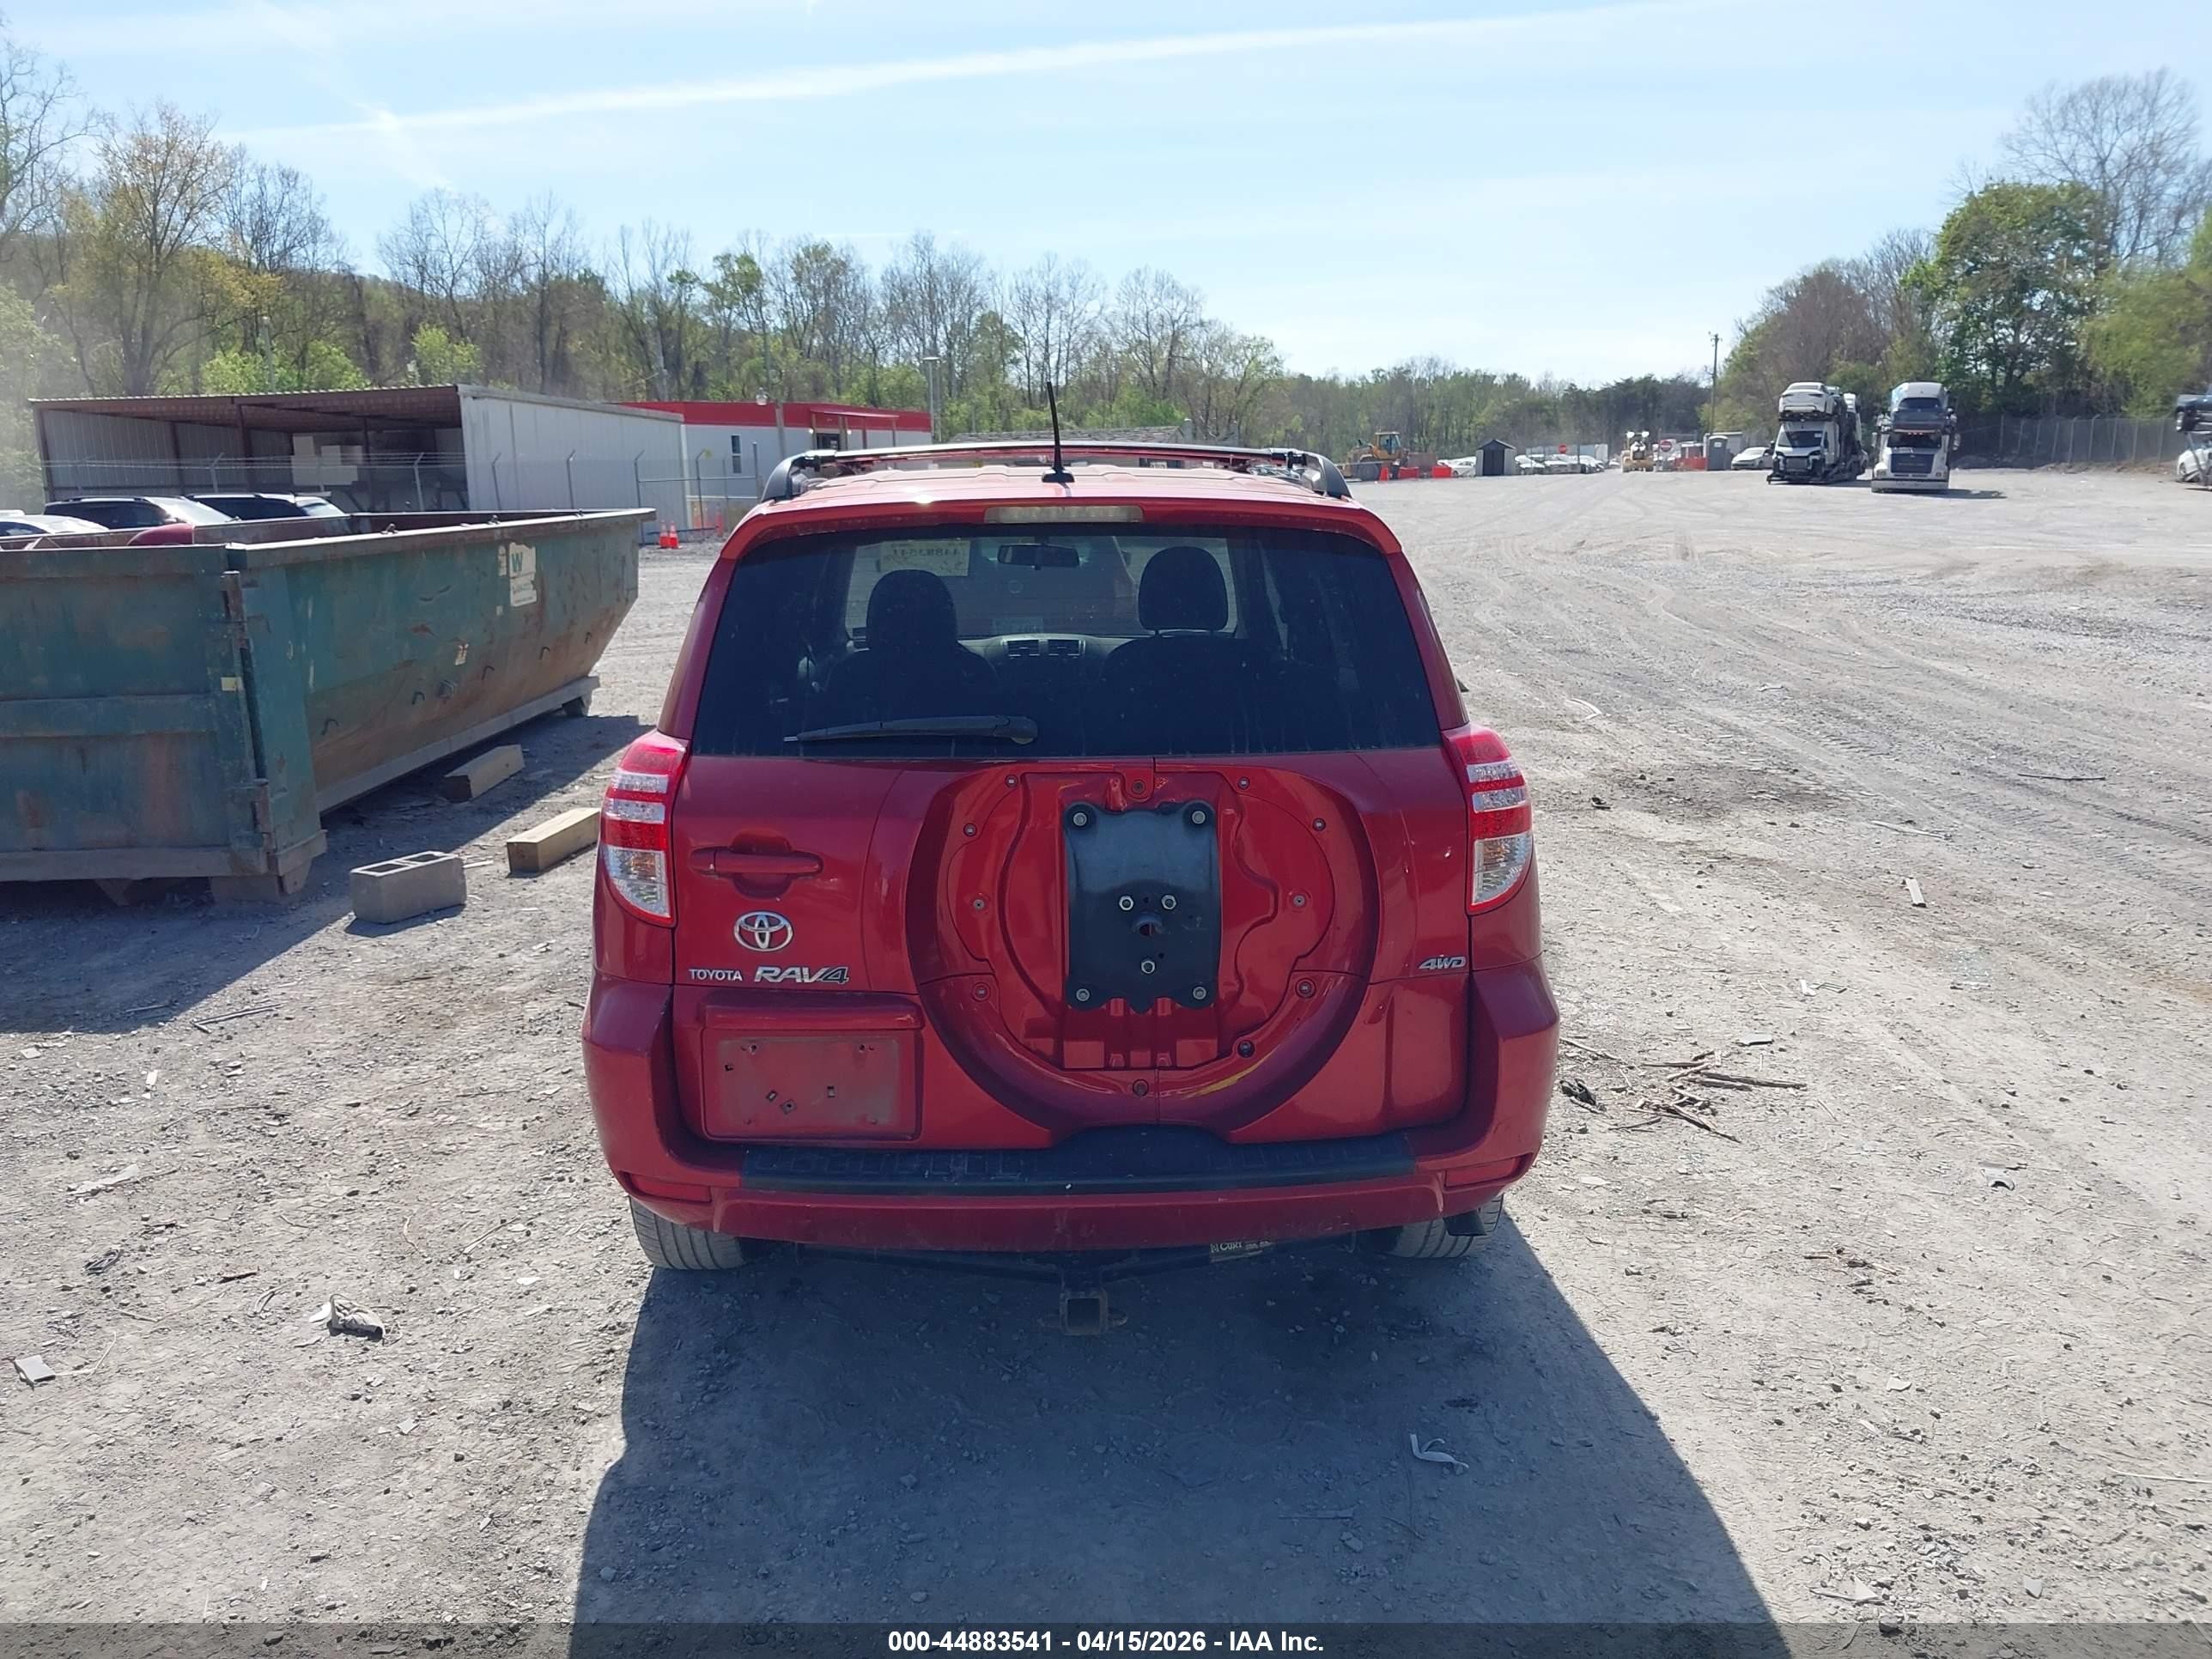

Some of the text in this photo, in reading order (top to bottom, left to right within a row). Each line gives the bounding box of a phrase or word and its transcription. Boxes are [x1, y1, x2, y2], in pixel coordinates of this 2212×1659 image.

[1419, 956, 1467, 970] 4WD
[689, 966, 849, 985] TOYOTA RAV4
